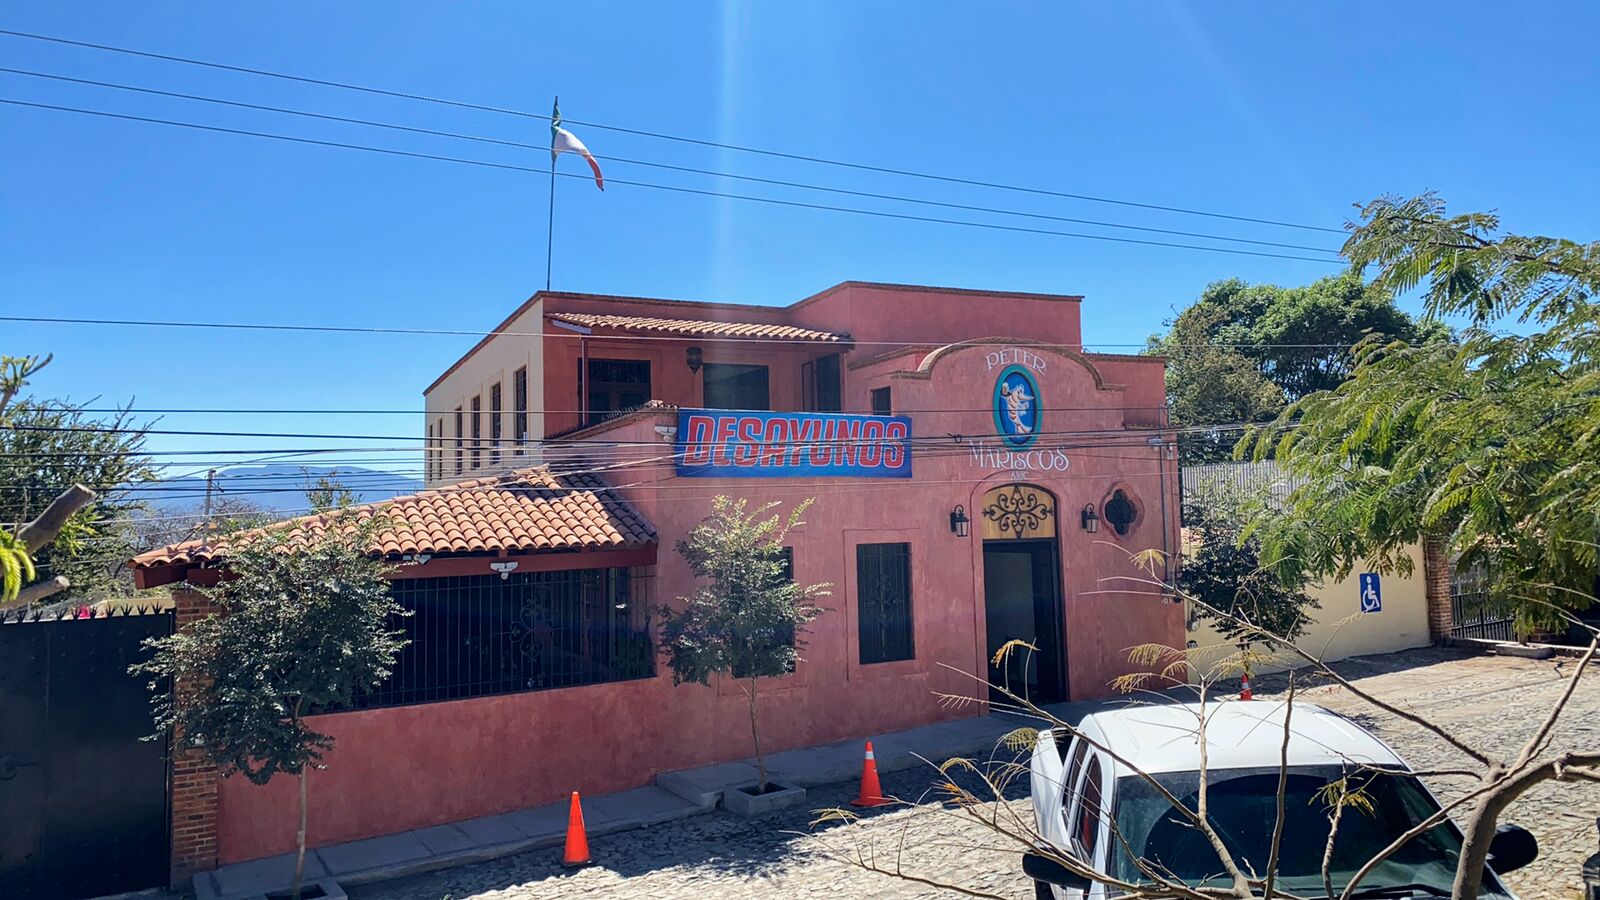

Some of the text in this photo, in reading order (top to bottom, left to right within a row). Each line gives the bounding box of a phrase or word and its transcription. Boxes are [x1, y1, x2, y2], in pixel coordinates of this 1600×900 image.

[985, 348, 1046, 376] PETER
[682, 415, 908, 468] DESAYUNOS
[969, 440, 1069, 471] MARISCOS
